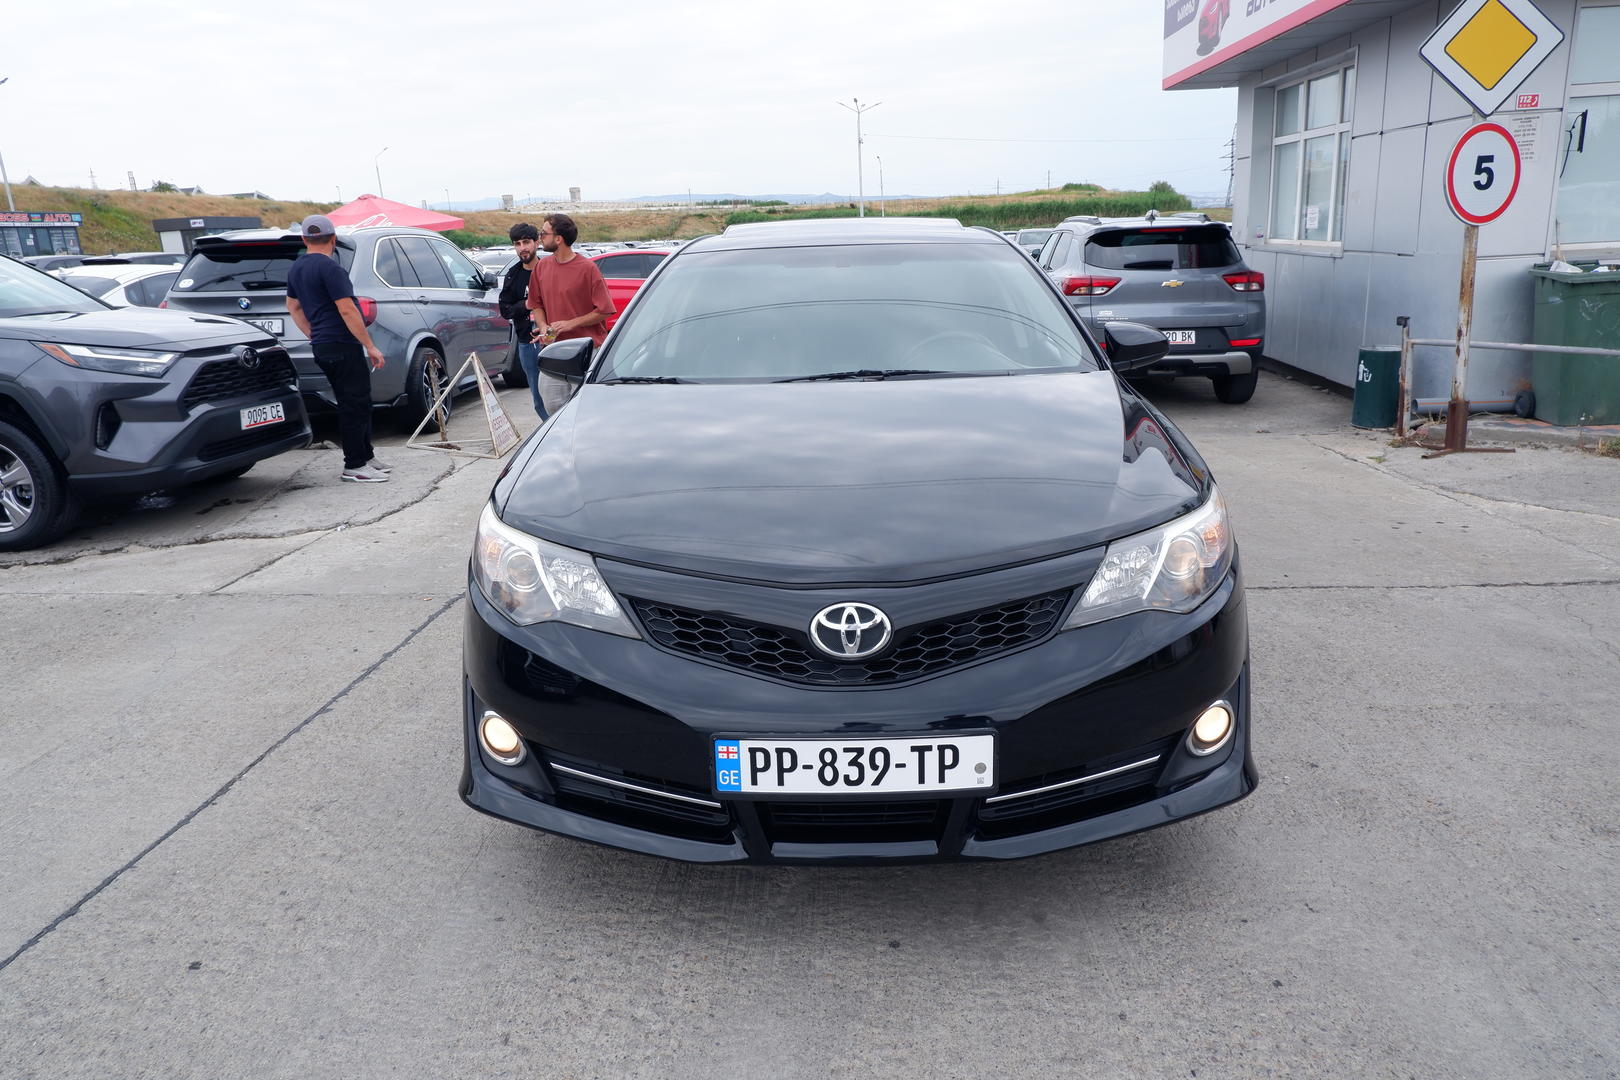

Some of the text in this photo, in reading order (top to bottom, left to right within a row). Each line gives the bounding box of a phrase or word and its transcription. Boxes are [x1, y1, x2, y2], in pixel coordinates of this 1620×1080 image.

[1519, 95, 1533, 104] 112
[1473, 155, 1494, 190] 5
[43, 213, 72, 222] AUTO
[1165, 331, 1193, 342] 20 BK
[247, 404, 283, 425] 9095 CE
[747, 744, 960, 787] PP-839-TP
[719, 770, 740, 786] GE
